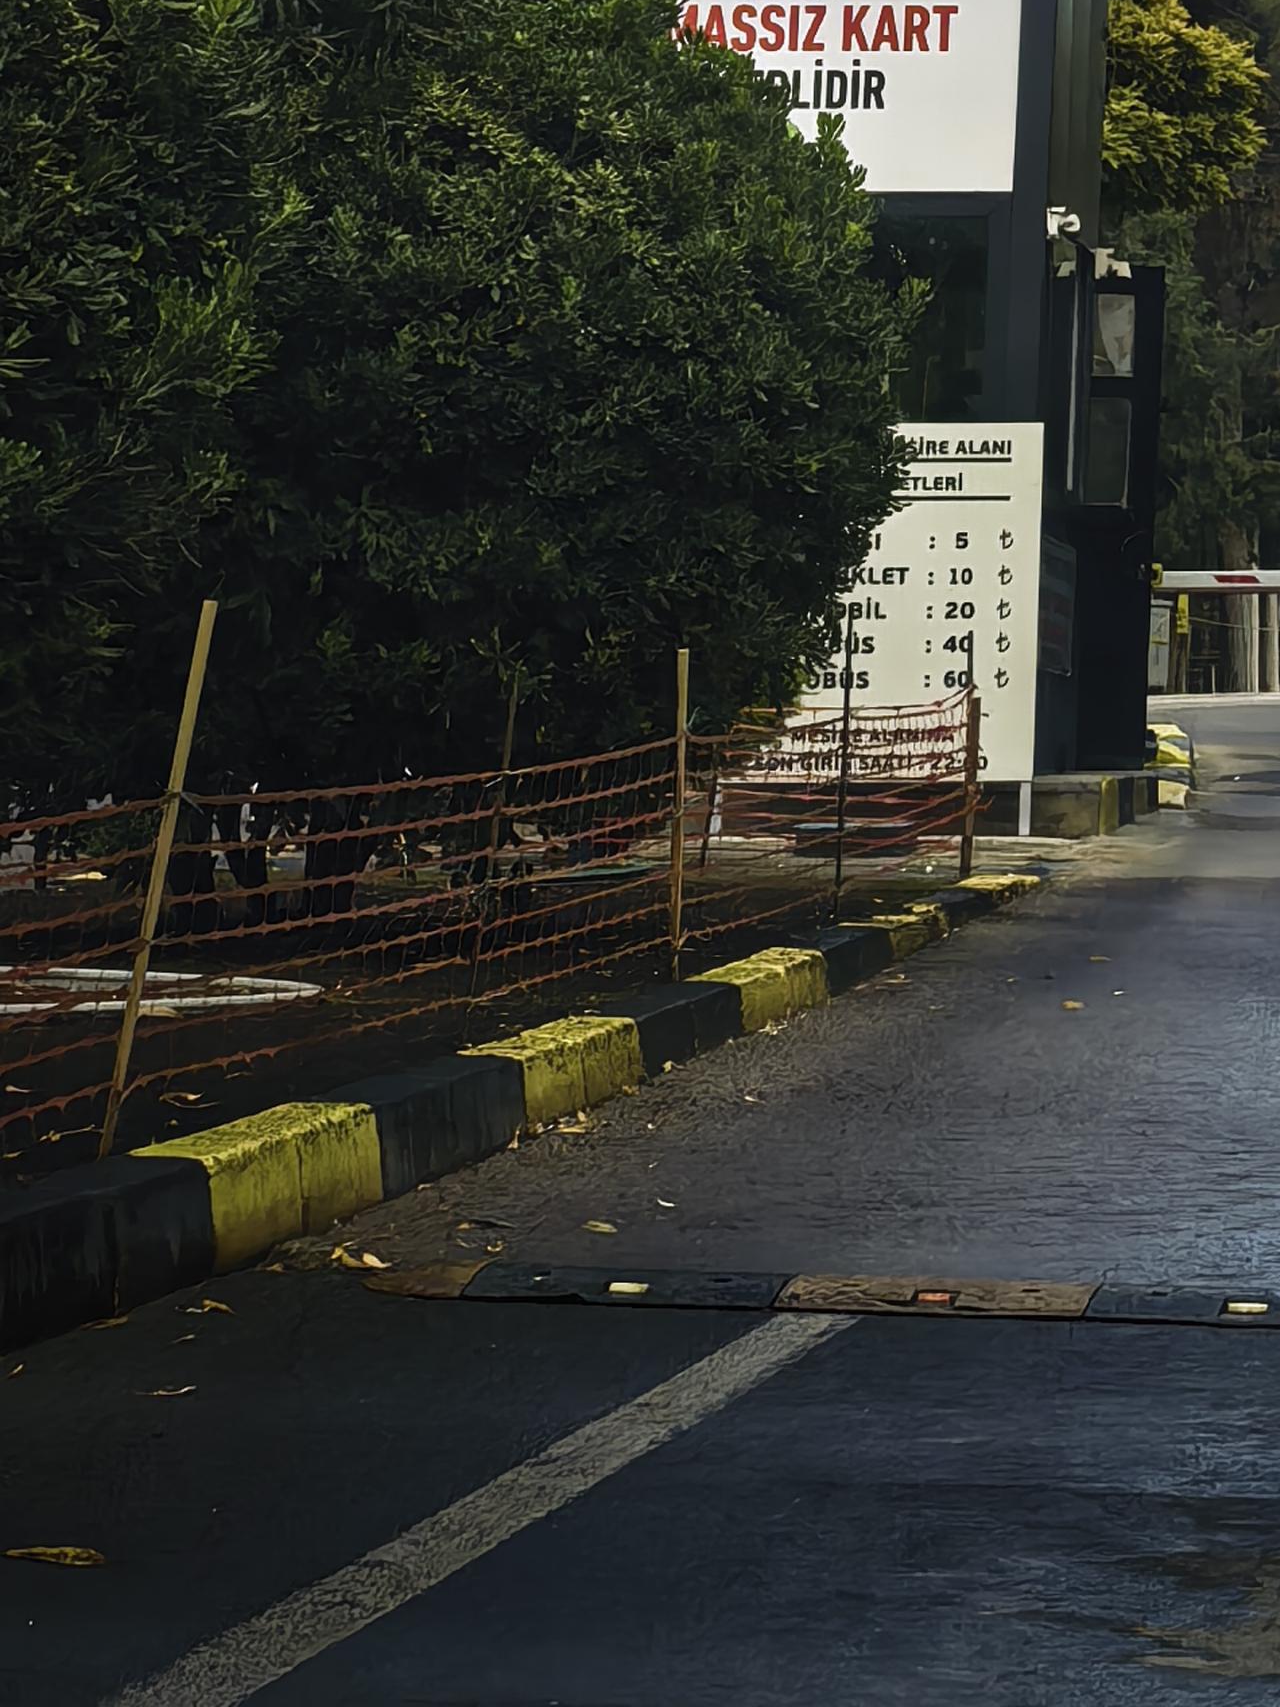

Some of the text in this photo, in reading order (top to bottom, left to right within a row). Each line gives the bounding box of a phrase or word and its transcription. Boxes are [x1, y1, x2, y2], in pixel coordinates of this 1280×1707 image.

[679, 4, 959, 52] ASSIZ KART
[905, 435, 1012, 456] SİRE ALANI
[900, 472, 963, 492] ETLERİ
[955, 532, 969, 549] 5
[949, 567, 973, 586] 10
[944, 602, 975, 620] 20
[943, 671, 970, 688] 60
